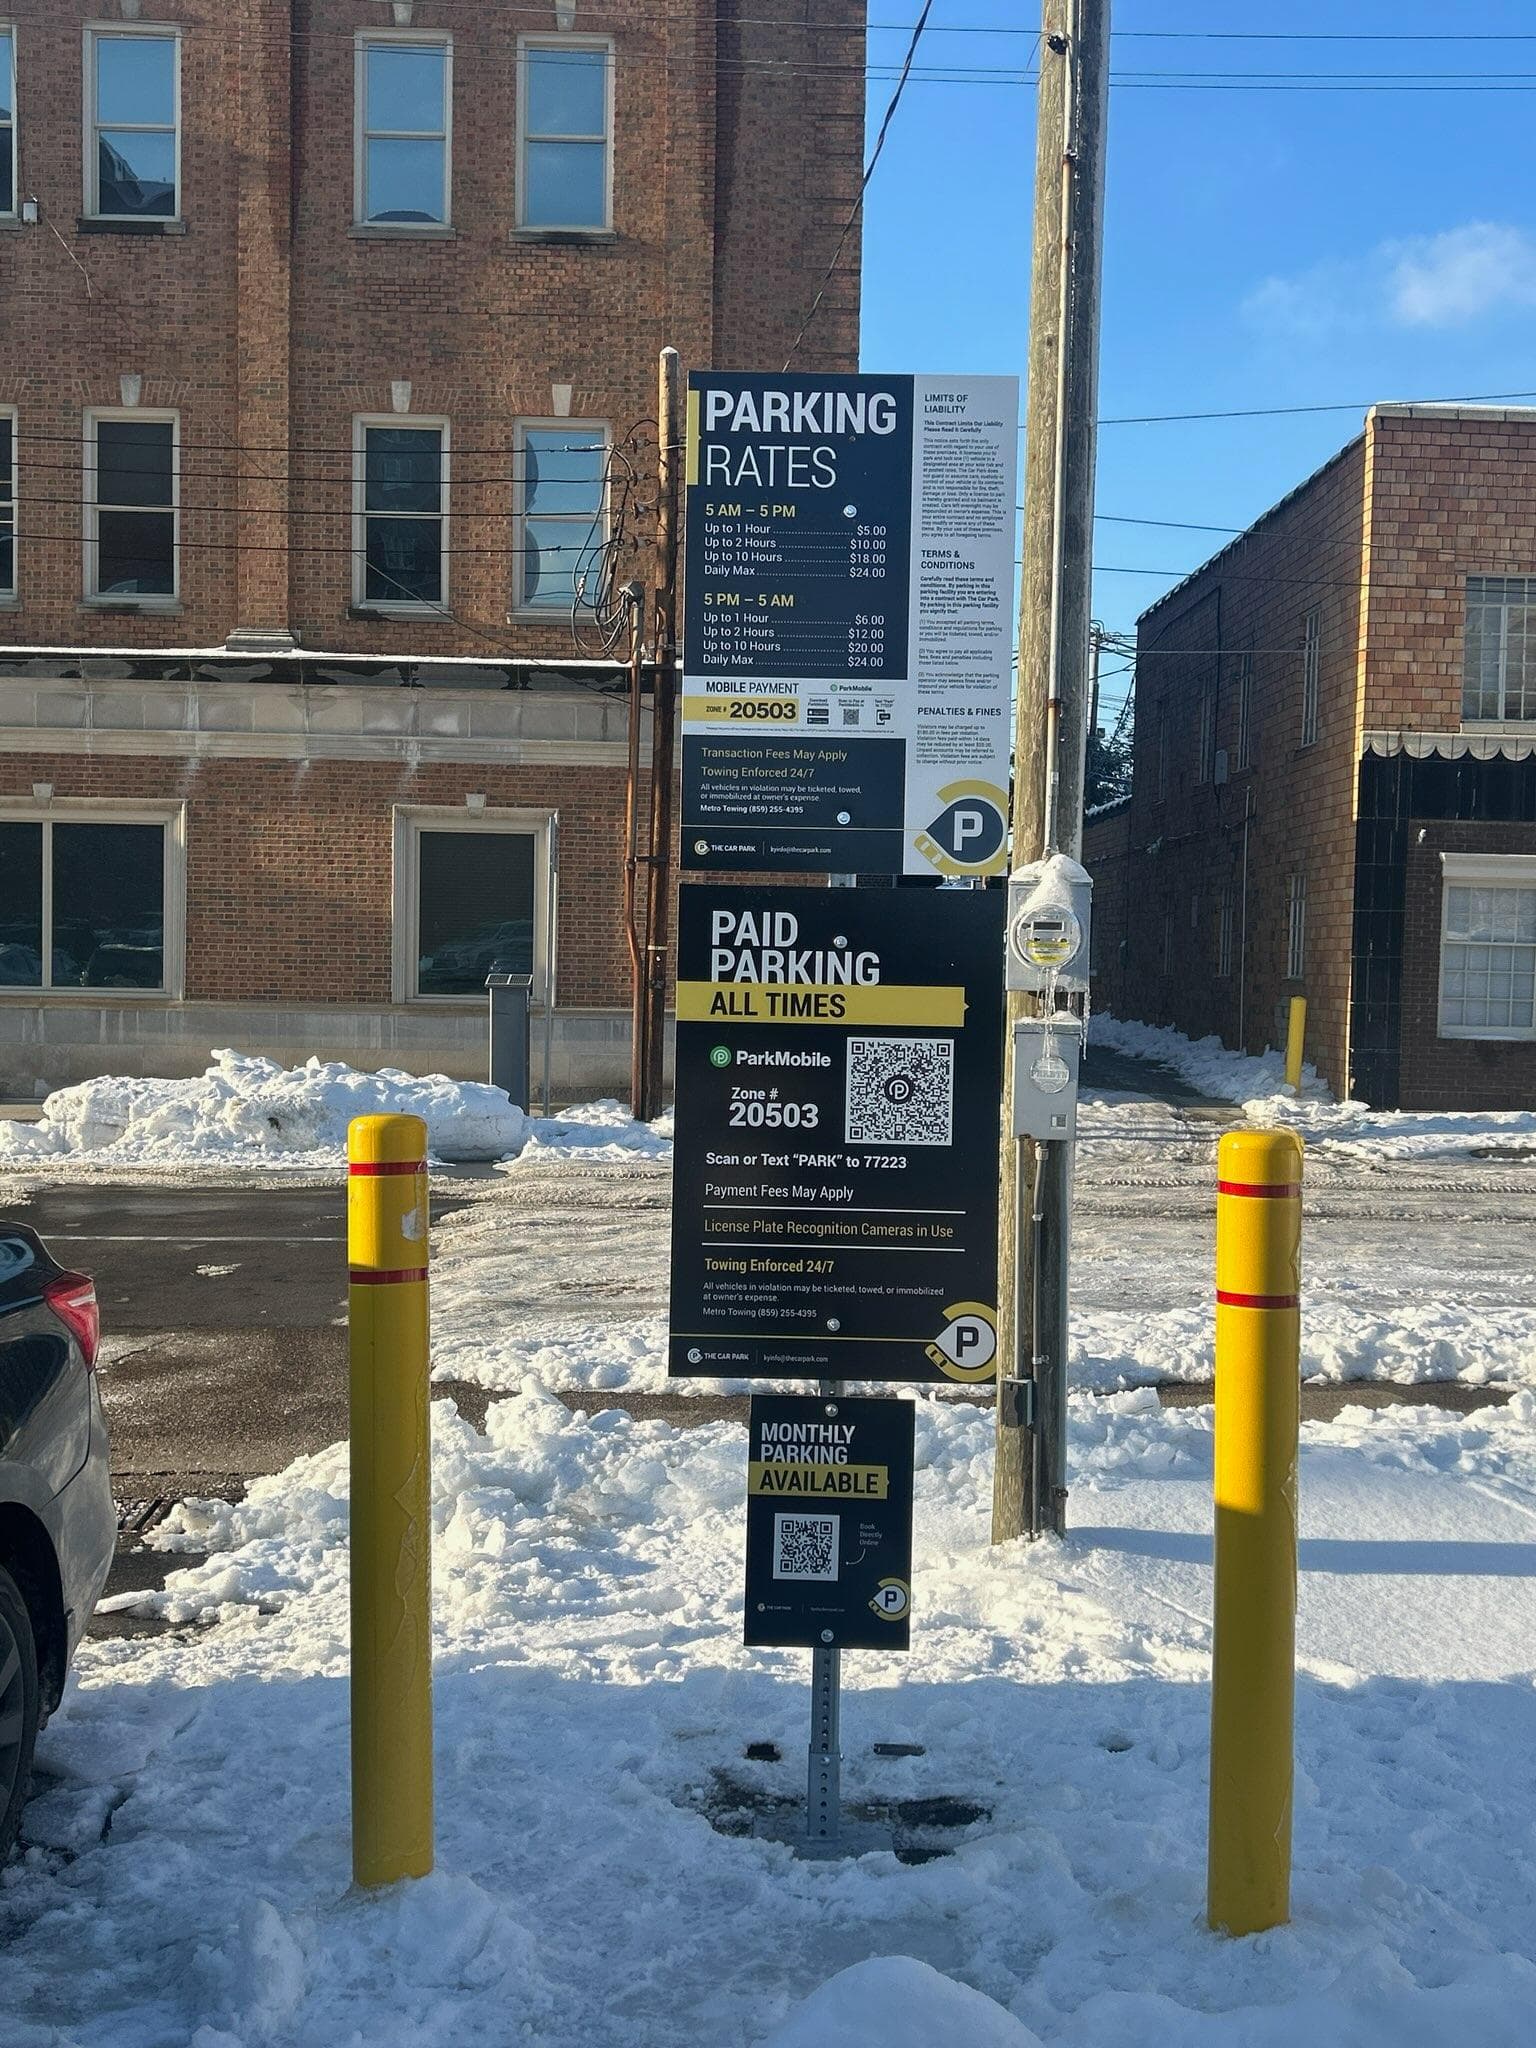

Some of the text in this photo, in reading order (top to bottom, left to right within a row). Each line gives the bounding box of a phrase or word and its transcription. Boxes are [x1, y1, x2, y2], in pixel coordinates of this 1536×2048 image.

[925, 394, 954, 402] LIMITS
[706, 390, 896, 435] PARKING
[924, 405, 966, 413] LIABILITY
[707, 445, 836, 488] RATES
[706, 504, 714, 516] 5
[718, 504, 741, 516] AM
[760, 505, 768, 517] 5
[773, 505, 795, 517] PM
[705, 524, 886, 536] Up to 1 Hour $5.00
[705, 538, 886, 550] Up to 2 Hours $10.00
[705, 552, 886, 564] Up to 10 Hours $18.00
[921, 550, 952, 558] TERMS
[704, 566, 885, 578] Daily Max $24.00
[921, 561, 975, 570] CONDITIONS
[704, 593, 712, 605] 5
[717, 593, 740, 606] PM
[758, 594, 767, 606] 5
[771, 594, 794, 607] AM
[704, 613, 884, 626] Up to 1 Hour $6.00
[704, 627, 884, 639] Up to 2 Hours $12.00
[704, 641, 717, 650] Up
[734, 641, 747, 650] 10
[750, 642, 781, 651] Hours
[848, 642, 884, 653] $20.00
[703, 655, 883, 667] Daily Max $24.00
[706, 681, 799, 694] MOBILE PAYMENT
[730, 702, 796, 719] 20503
[918, 707, 965, 716] PENALTIES
[701, 748, 847, 762] Transaction Fees May Apply
[701, 766, 814, 779] Towing Enforced 24/7
[723, 805, 748, 814] Towing
[749, 805, 768, 814] (859)
[712, 910, 798, 947] PAID
[711, 949, 880, 986] PARKING
[710, 991, 846, 1018] ALL TIMES
[736, 1051, 831, 1067] ParkMobile
[731, 1087, 778, 1100] Zone #
[729, 1102, 818, 1128] 20503
[706, 1152, 739, 1165] Scan
[743, 1156, 758, 1165] or
[761, 1154, 789, 1166] Text
[846, 1156, 860, 1167] to
[864, 1156, 907, 1168] 77223
[706, 1184, 854, 1202] Payment Fees May Apply
[705, 1219, 953, 1237] License Plate Recognition Cameras in Use
[705, 1258, 834, 1274] Towing Enforced 24/7
[715, 1282, 747, 1290] vehicles
[896, 1287, 944, 1295] immobilized
[703, 1307, 817, 1318] Metro Towing (859) 255-4395
[762, 1423, 856, 1444] MONTHLY
[760, 1444, 848, 1465] PARKING
[760, 1470, 879, 1494] AVAILABLE
